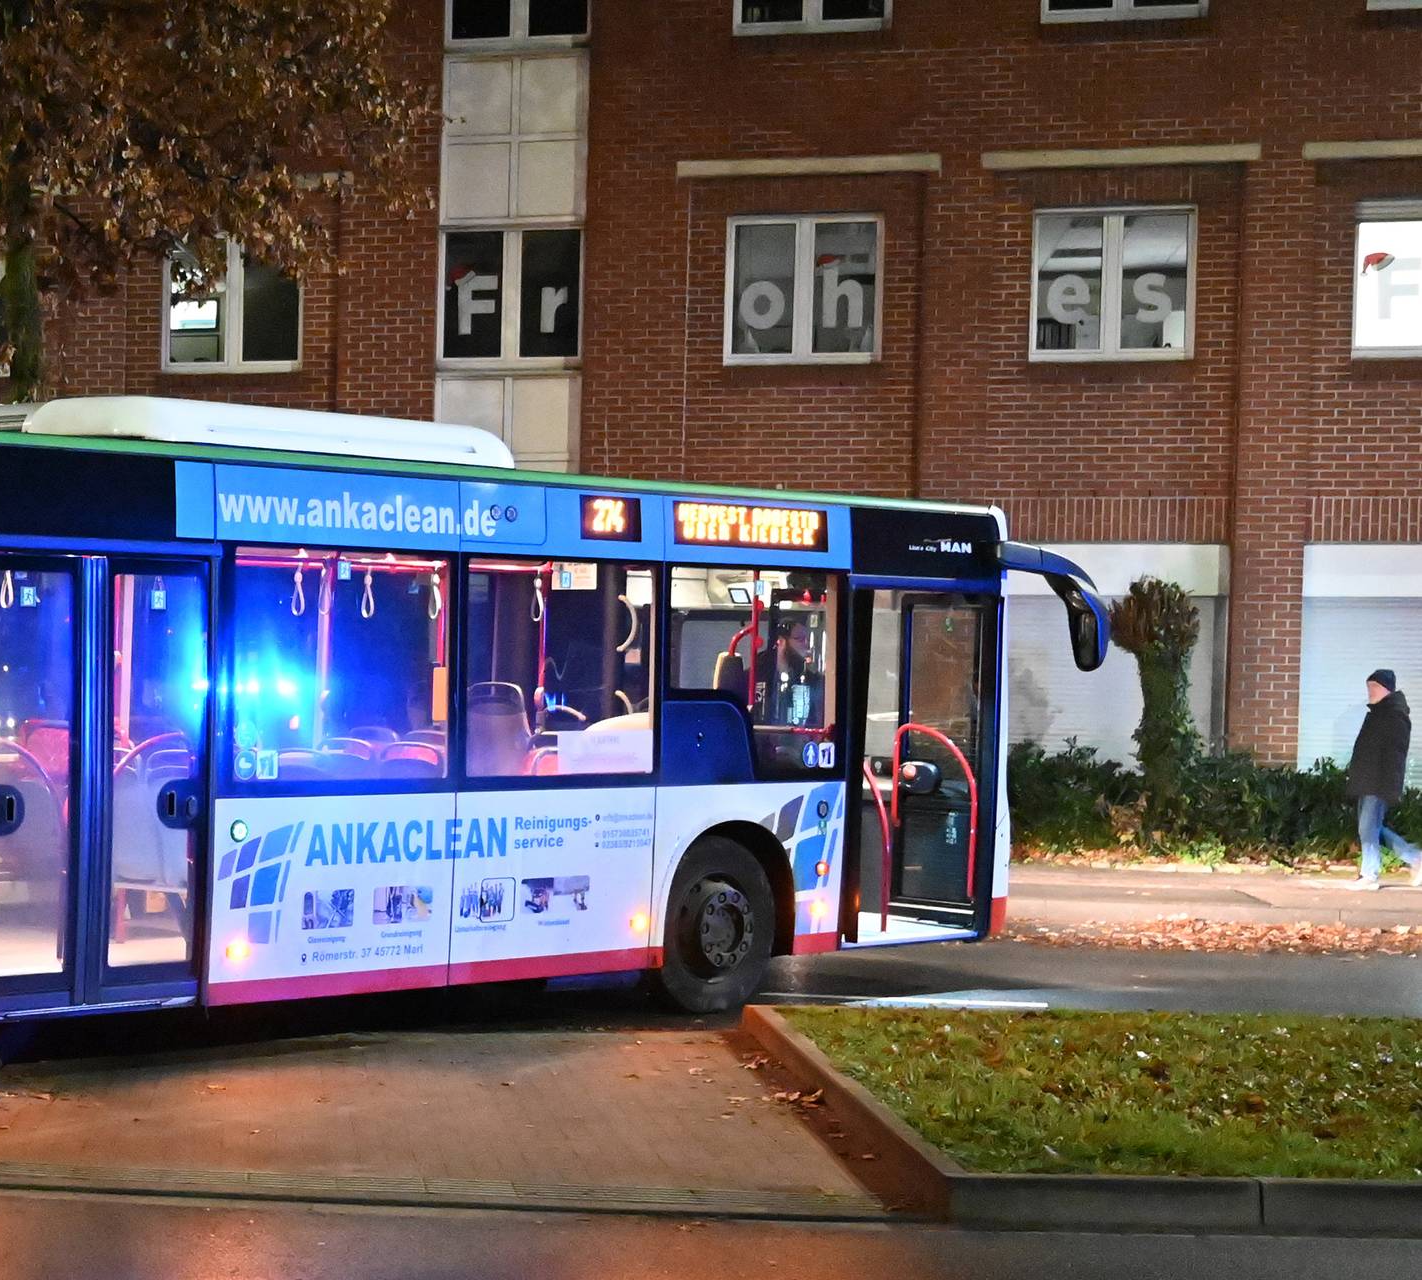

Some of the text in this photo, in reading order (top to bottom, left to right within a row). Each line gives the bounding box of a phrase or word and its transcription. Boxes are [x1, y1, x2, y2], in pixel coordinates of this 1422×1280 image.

[218, 492, 498, 537] www.ankaclean.de
[940, 541, 972, 554] MAN
[514, 816, 592, 833] Reinigungs-
[305, 817, 507, 866] ANKACLEAN
[514, 835, 564, 849] service
[362, 948, 372, 957] 37
[374, 946, 402, 957] 45772
[404, 944, 423, 954] Marl
